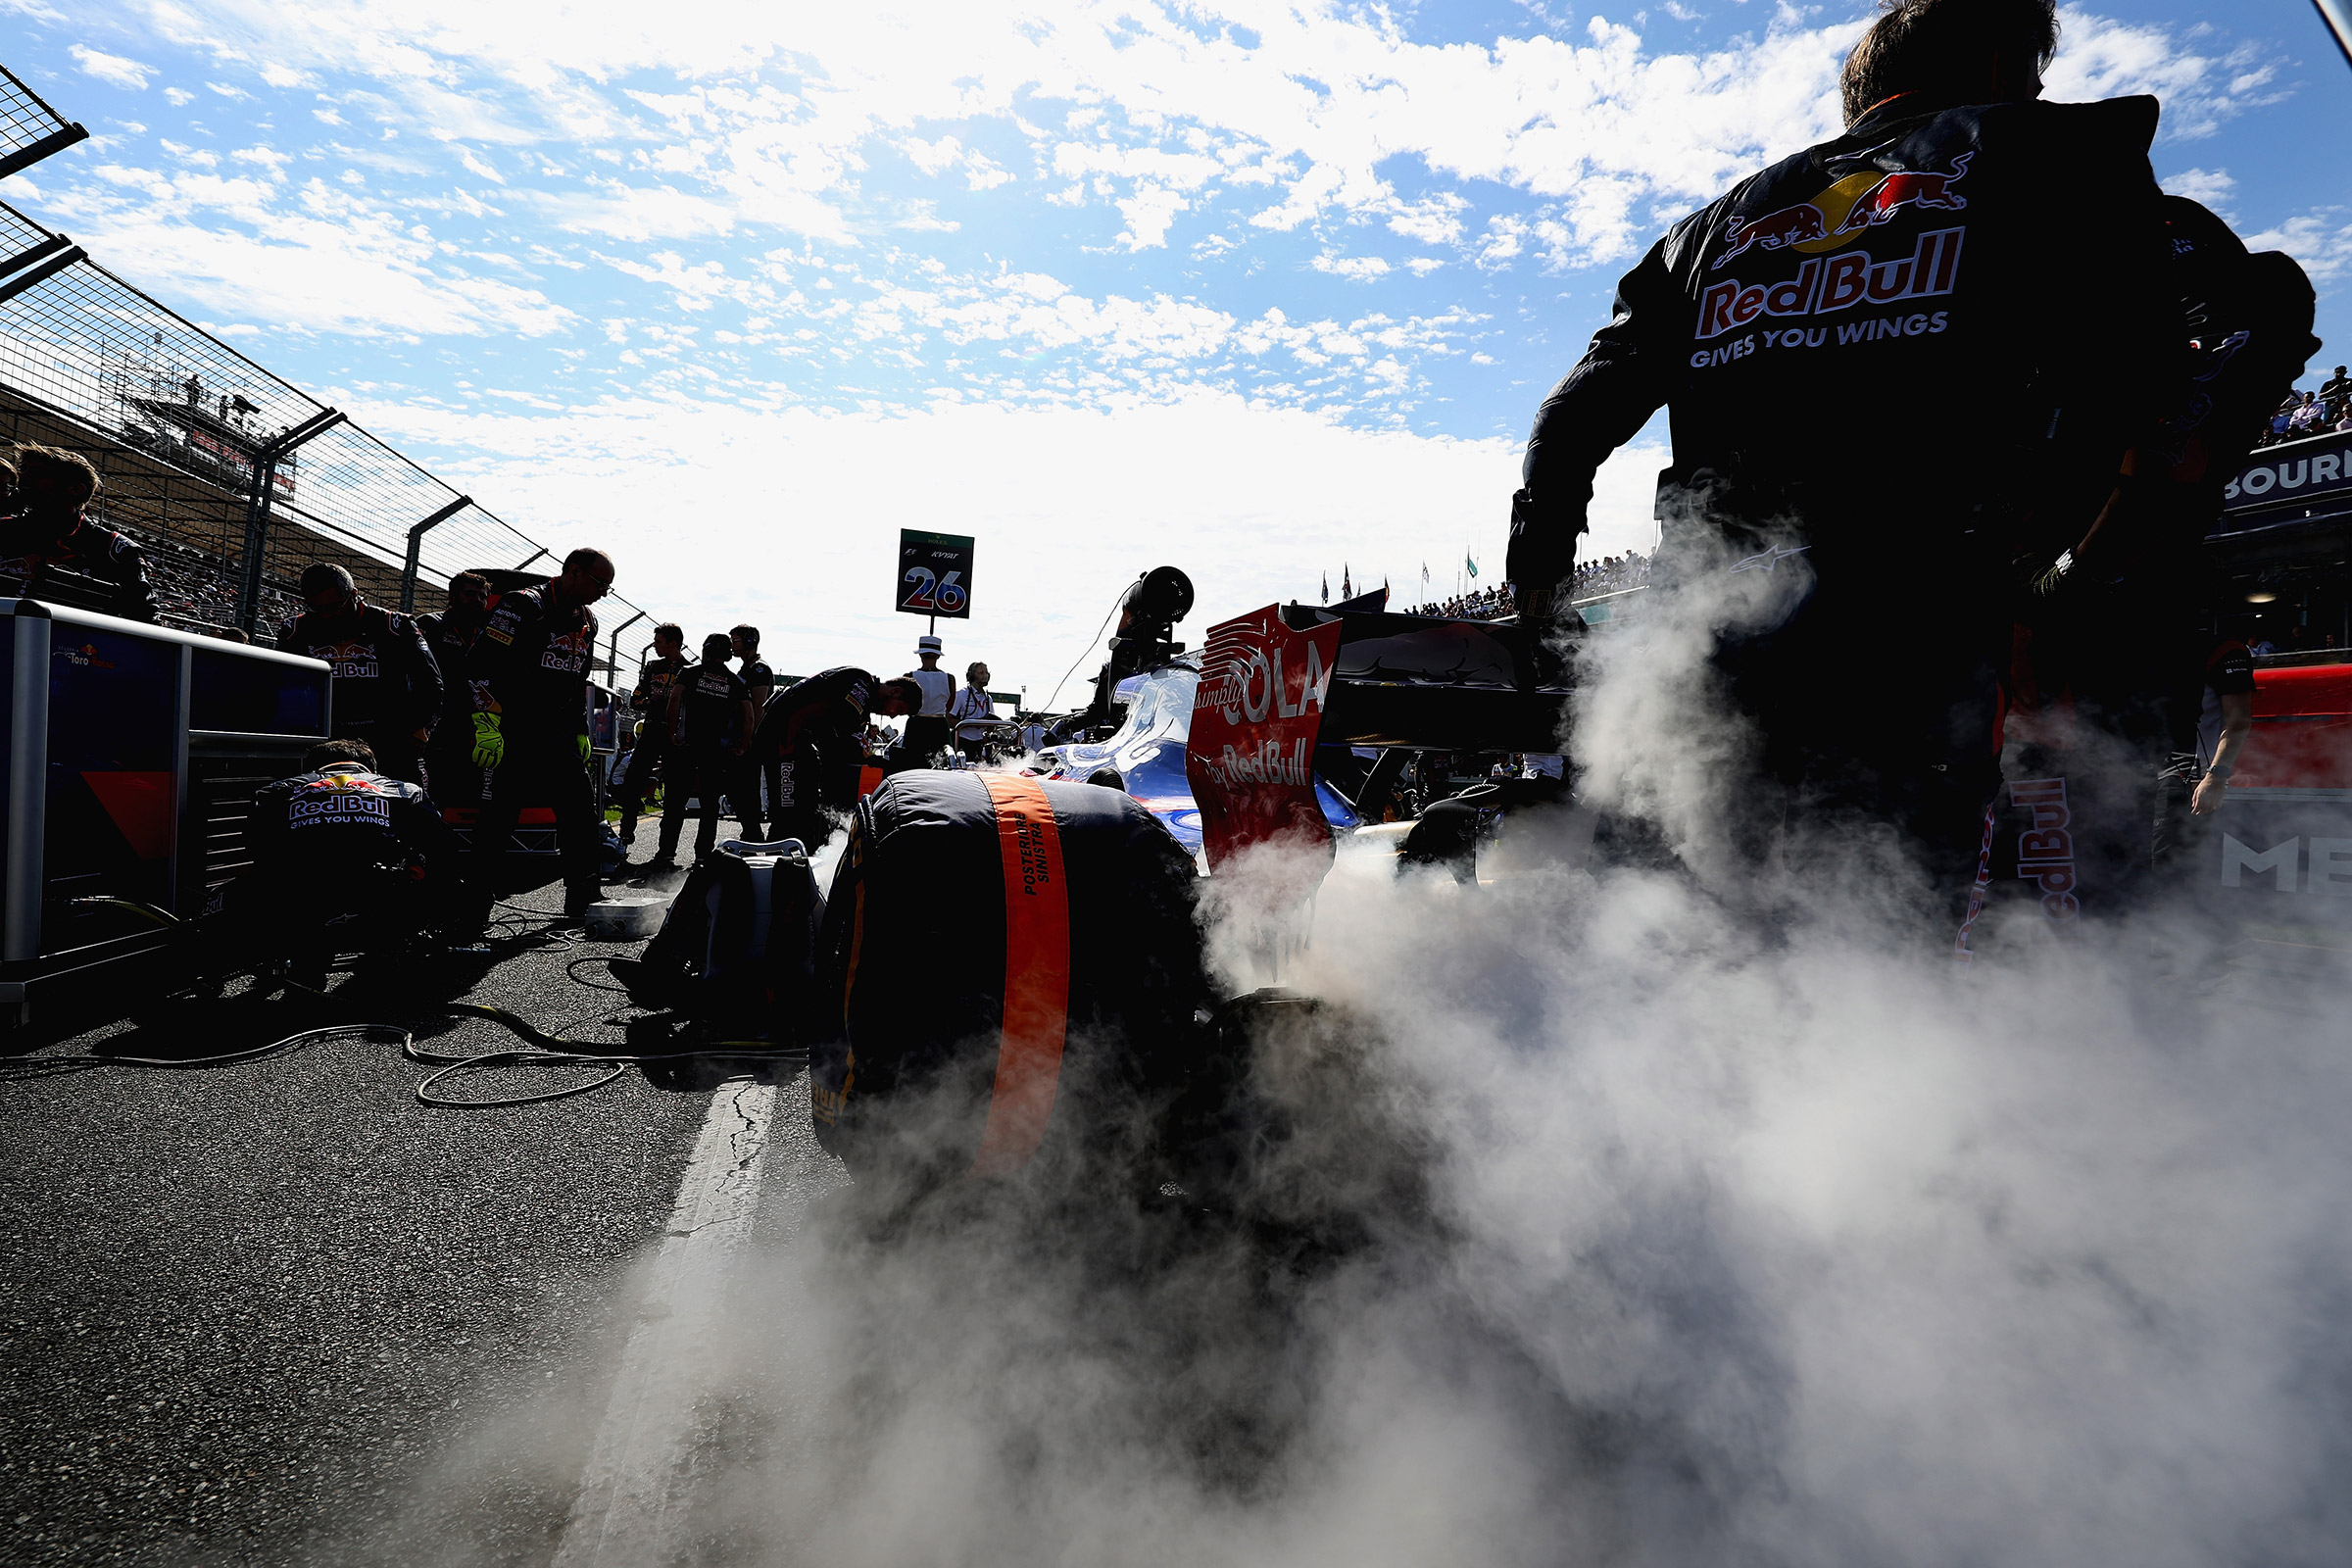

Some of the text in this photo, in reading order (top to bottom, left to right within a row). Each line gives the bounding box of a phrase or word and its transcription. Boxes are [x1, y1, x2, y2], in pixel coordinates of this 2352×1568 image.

[1694, 225, 1967, 339] Red Bull
[1690, 311, 1949, 368] GIVES YOU WINGS
[931, 551, 959, 560] KVYAT
[902, 566, 966, 612] 26
[70, 653, 88, 665] Toro
[344, 662, 379, 678] Bull
[541, 652, 572, 672] Red
[1194, 683, 1242, 713] simply
[781, 761, 795, 807] Red Bull
[1207, 737, 1306, 791] by Red Bull
[289, 795, 390, 820] Red Bull
[290, 816, 321, 830] GIVES
[354, 816, 390, 828] WINGS
[2008, 777, 2074, 860] Bull
[1013, 812, 1037, 896] POSTERIORE
[1030, 823, 1050, 883] SINISTRA
